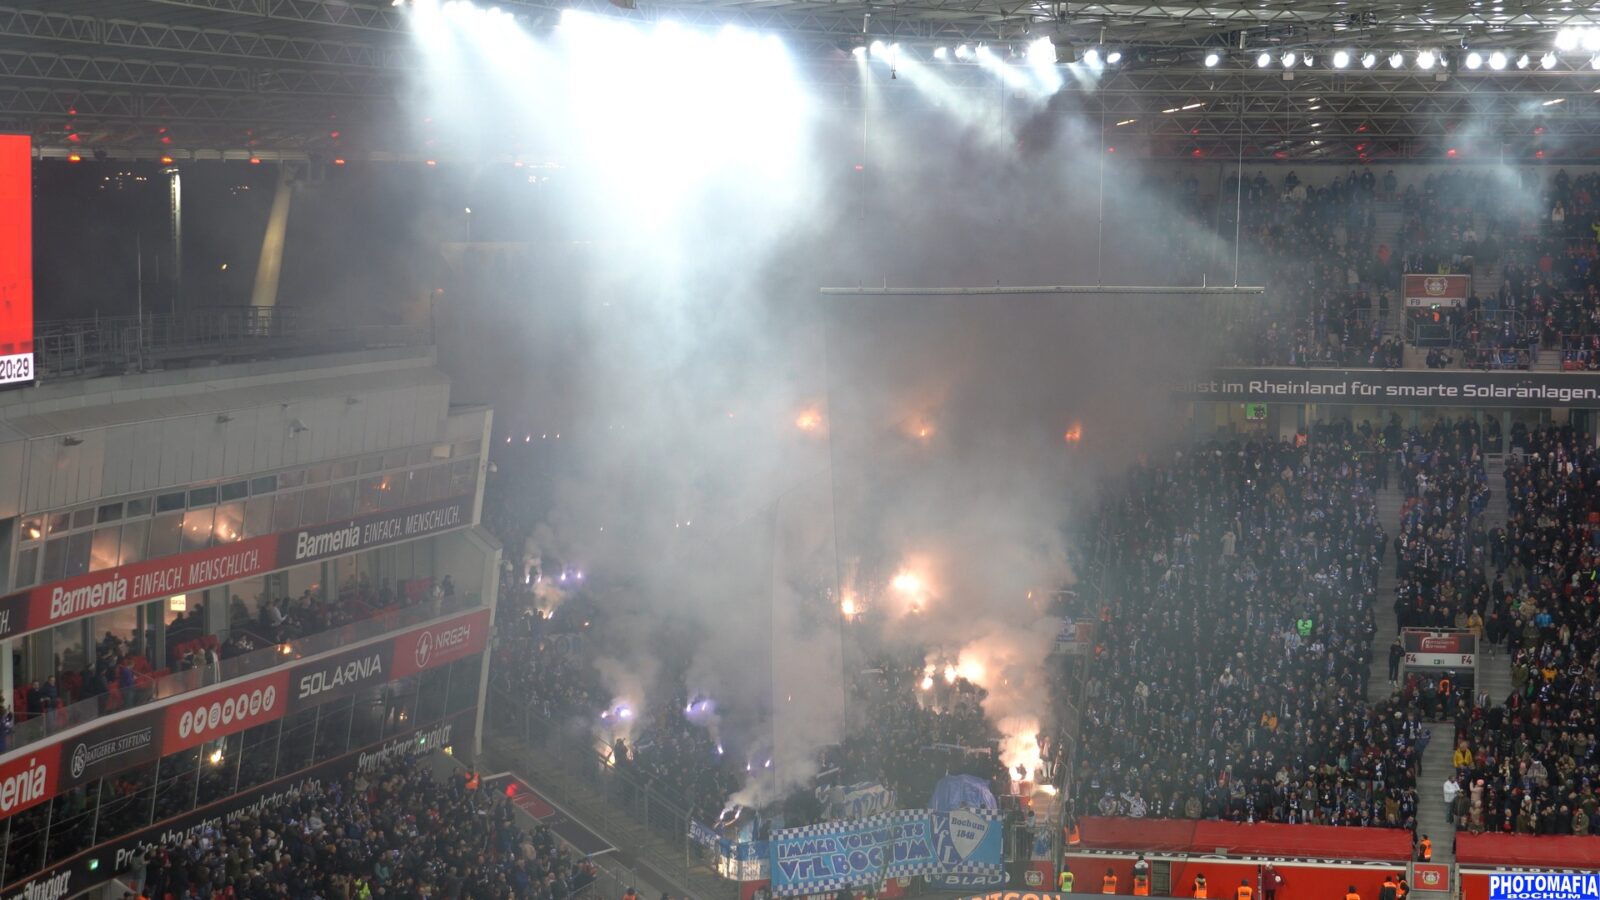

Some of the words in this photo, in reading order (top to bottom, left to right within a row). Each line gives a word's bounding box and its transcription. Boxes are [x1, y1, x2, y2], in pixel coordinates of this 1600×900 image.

[0, 357, 29, 380] 20:29
[1222, 380, 1243, 393] im
[1249, 380, 1346, 395] Rheinland
[1351, 381, 1382, 395] für
[1386, 384, 1458, 397] smarte
[1463, 383, 1600, 402] Solaranlagen.
[296, 520, 359, 560] Barmenia
[364, 517, 402, 544] EINFACH.
[405, 504, 460, 535] MENSCHLICH.
[50, 572, 128, 619] Barmenia
[133, 566, 185, 598] EINFACH.
[188, 548, 260, 586] MENSCHLICH.
[435, 624, 471, 649] NRG24
[1405, 654, 1416, 664] F4
[1461, 655, 1472, 664] F4
[298, 654, 382, 700] SOLARNIA
[86, 742, 116, 763] RATGEBER
[118, 731, 152, 751] STIFTUNG
[0, 758, 47, 812] enia
[951, 817, 985, 831] Bochum
[957, 830, 976, 840] 1848
[778, 838, 836, 860] IMMER
